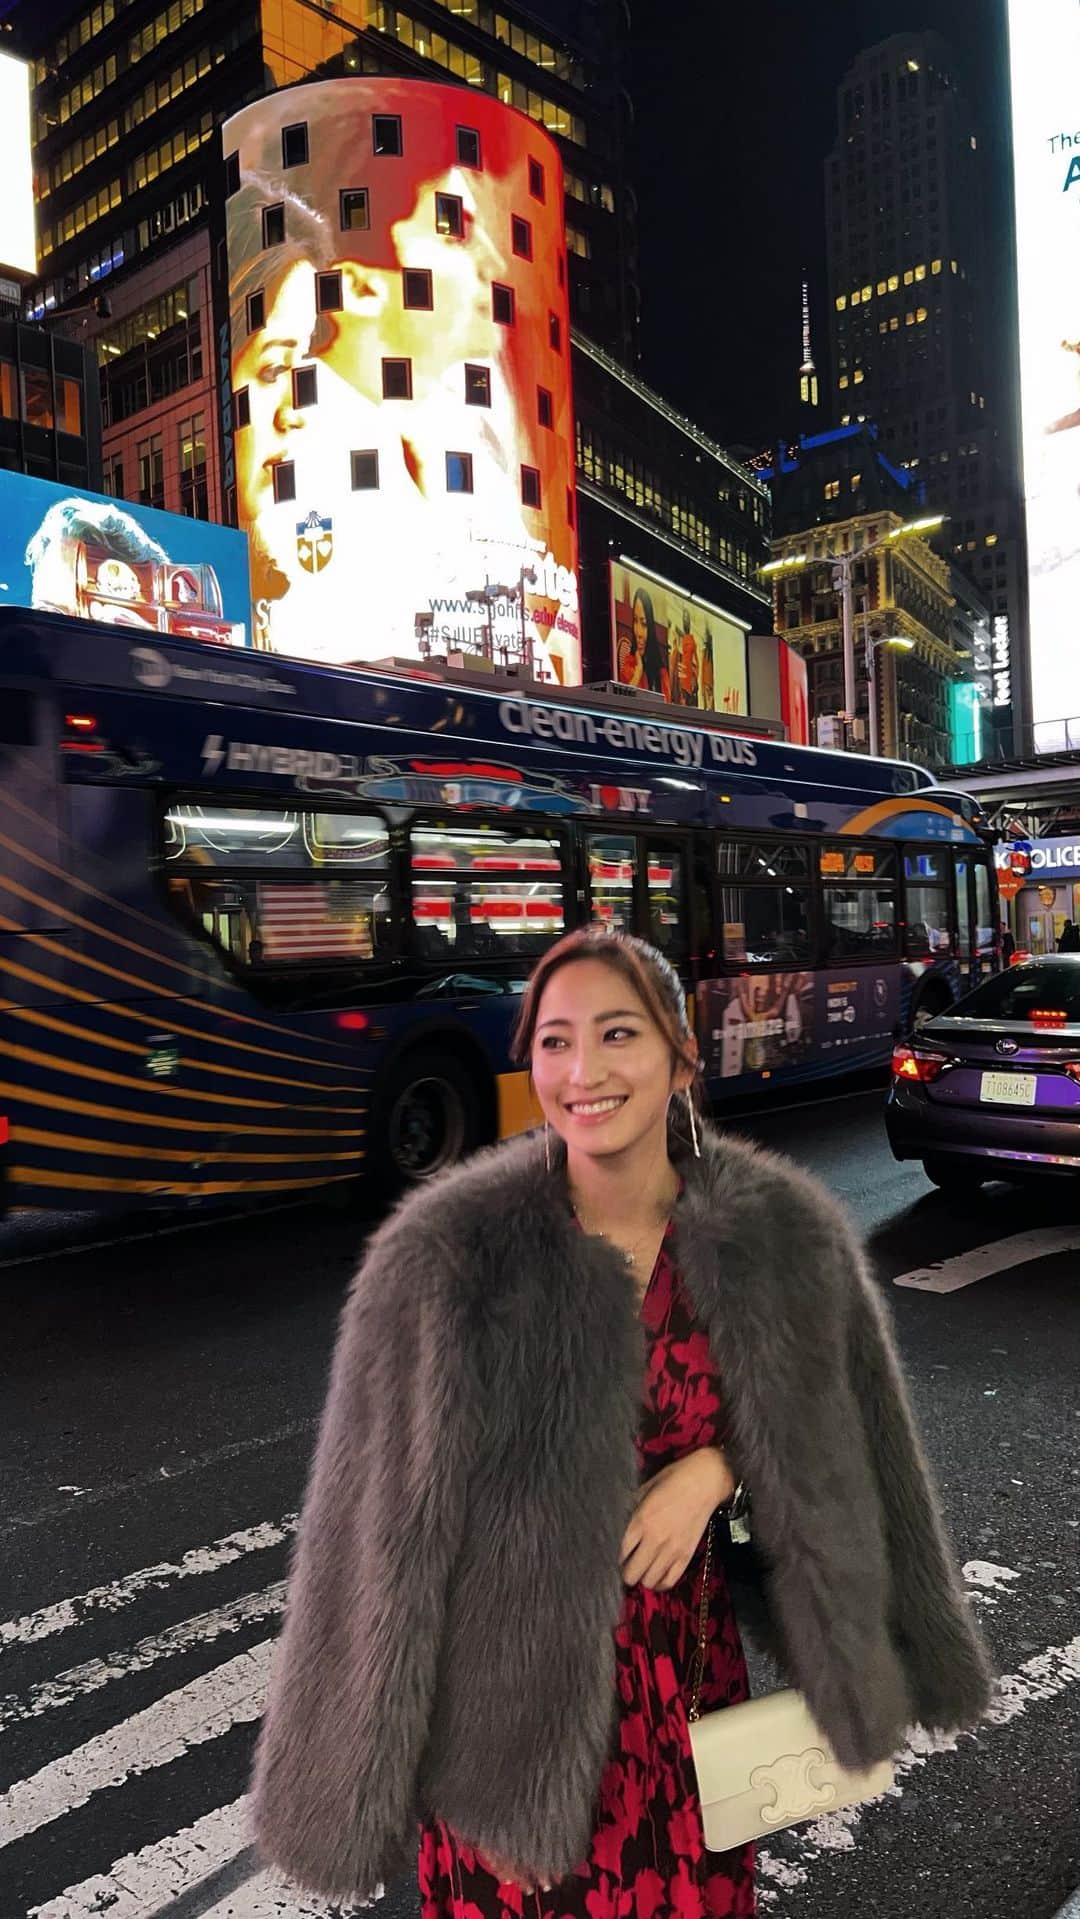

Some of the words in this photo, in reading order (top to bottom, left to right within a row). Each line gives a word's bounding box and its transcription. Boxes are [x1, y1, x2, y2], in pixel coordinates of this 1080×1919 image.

[991, 615, 1010, 669] Locker
[993, 671, 1011, 706] Foot
[708, 734, 758, 767] bus
[589, 784, 604, 809] I
[617, 788, 652, 812] NY
[1030, 845, 1080, 869] OLICE
